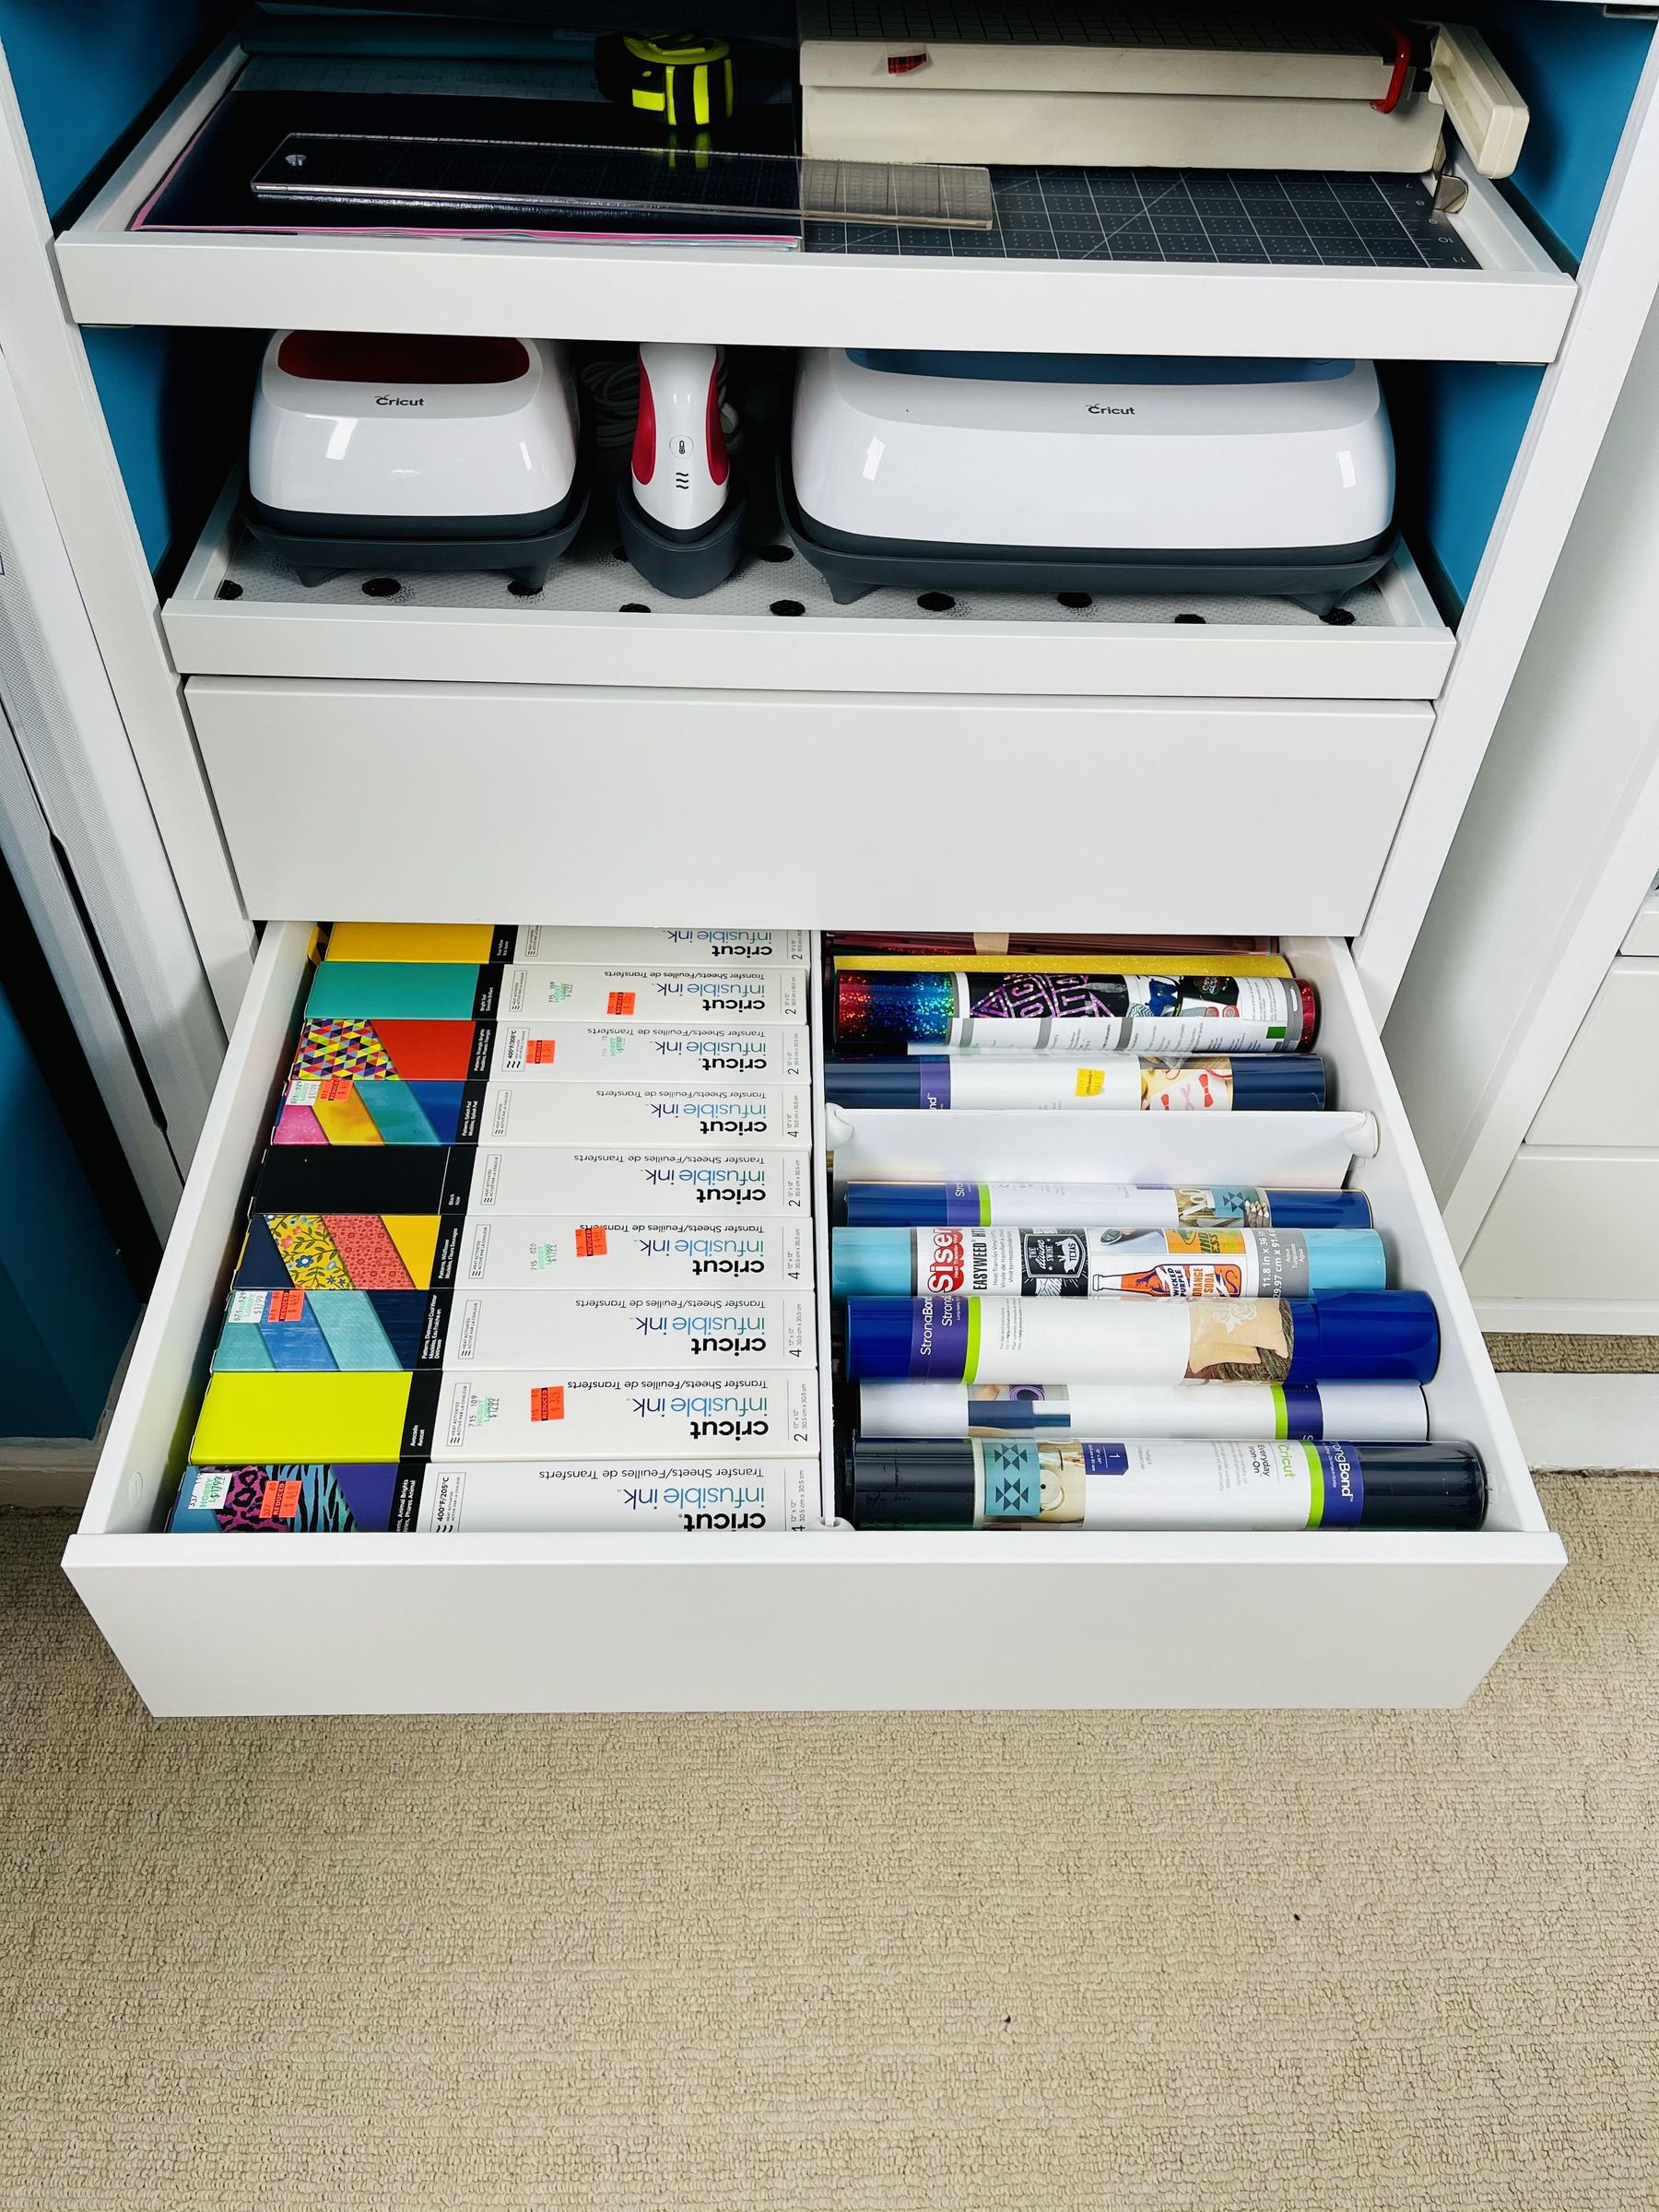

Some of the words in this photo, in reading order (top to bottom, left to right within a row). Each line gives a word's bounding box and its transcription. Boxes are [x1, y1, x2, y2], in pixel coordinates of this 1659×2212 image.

[375, 394, 425, 407] Cricut
[1088, 403, 1136, 416] Cricut
[696, 930, 772, 944] infusible
[712, 945, 772, 959] cricut
[604, 971, 648, 979] Transferts
[730, 972, 765, 981] Transfer
[688, 983, 765, 997] infusible
[702, 999, 766, 1014] cricut
[587, 1028, 636, 1036] Transferts
[638, 1029, 652, 1037] de
[653, 1029, 724, 1037] Sheets/Feuilles
[726, 1030, 765, 1038] Transfer
[686, 1041, 766, 1056] infusible
[701, 1058, 767, 1073] cricut
[595, 1089, 641, 1099] Transferts
[643, 1090, 656, 1100] de
[658, 1090, 728, 1100] Sheets/Feuilles
[729, 1090, 766, 1100] Transfer
[683, 1103, 767, 1119] infusible
[700, 1121, 768, 1136] cricut
[573, 1154, 624, 1164] Transferts
[627, 1156, 641, 1164] de
[643, 1155, 722, 1164] Sheets/Feuilles
[724, 1156, 765, 1164] Transfer
[679, 1169, 766, 1186] infusible
[696, 1189, 766, 1206] cricut
[631, 1224, 644, 1233] de
[646, 1224, 723, 1233] Sheets/Feuilles
[724, 1225, 764, 1233] Transfer
[674, 1240, 764, 1258] infusible
[1260, 1238, 1267, 1246] 36
[1035, 1240, 1046, 1269] divine
[1068, 1243, 1077, 1261] TEXAS
[1290, 1243, 1299, 1268] Turquoise
[1298, 1248, 1306, 1262] Agua
[1262, 1256, 1270, 1265] in
[1275, 1257, 1282, 1272] cm
[692, 1260, 764, 1277] cricut
[1167, 1266, 1179, 1297] WICKED
[1175, 1268, 1188, 1297] PURPLE
[1193, 1268, 1203, 1297] ORANGE
[1205, 1273, 1214, 1293] SODA
[1263, 1268, 1272, 1288] 11.8
[1273, 1276, 1282, 1298] 29.97
[280, 1292, 288, 1320] REDUCED
[575, 1300, 627, 1309] Transferts
[629, 1300, 642, 1309] de
[643, 1300, 723, 1309] Sheets/Feuilles
[724, 1300, 765, 1309] Transfer
[672, 1317, 765, 1336] infusible
[691, 1338, 767, 1356] cricut
[567, 1380, 620, 1391] Transferts
[623, 1381, 639, 1390] de
[641, 1380, 721, 1390] Sheets/Feuilles
[723, 1380, 768, 1389] Transfer
[670, 1396, 768, 1418] infusible
[410, 1425, 419, 1447] Avocado
[690, 1421, 769, 1441] cricut
[794, 1433, 808, 1441] 2
[417, 1430, 425, 1447] Avocat
[1257, 1445, 1271, 1477] Everyday
[1277, 1444, 1296, 1478] Cricut
[539, 1470, 598, 1481] Transferts
[602, 1469, 618, 1480] de
[621, 1468, 714, 1480] Sheets/Feuilles
[716, 1468, 764, 1479] Transfer
[799, 1470, 804, 1479] cm
[199, 1477, 212, 1508] HOBBY
[400, 1479, 409, 1498] Brights
[407, 1479, 417, 1499] Animal
[274, 1483, 285, 1515] REDUCED
[664, 1487, 764, 1510] infusible
[799, 1500, 805, 1508] cm
[396, 1499, 406, 1518] Animal
[683, 1512, 766, 1533] cricut
